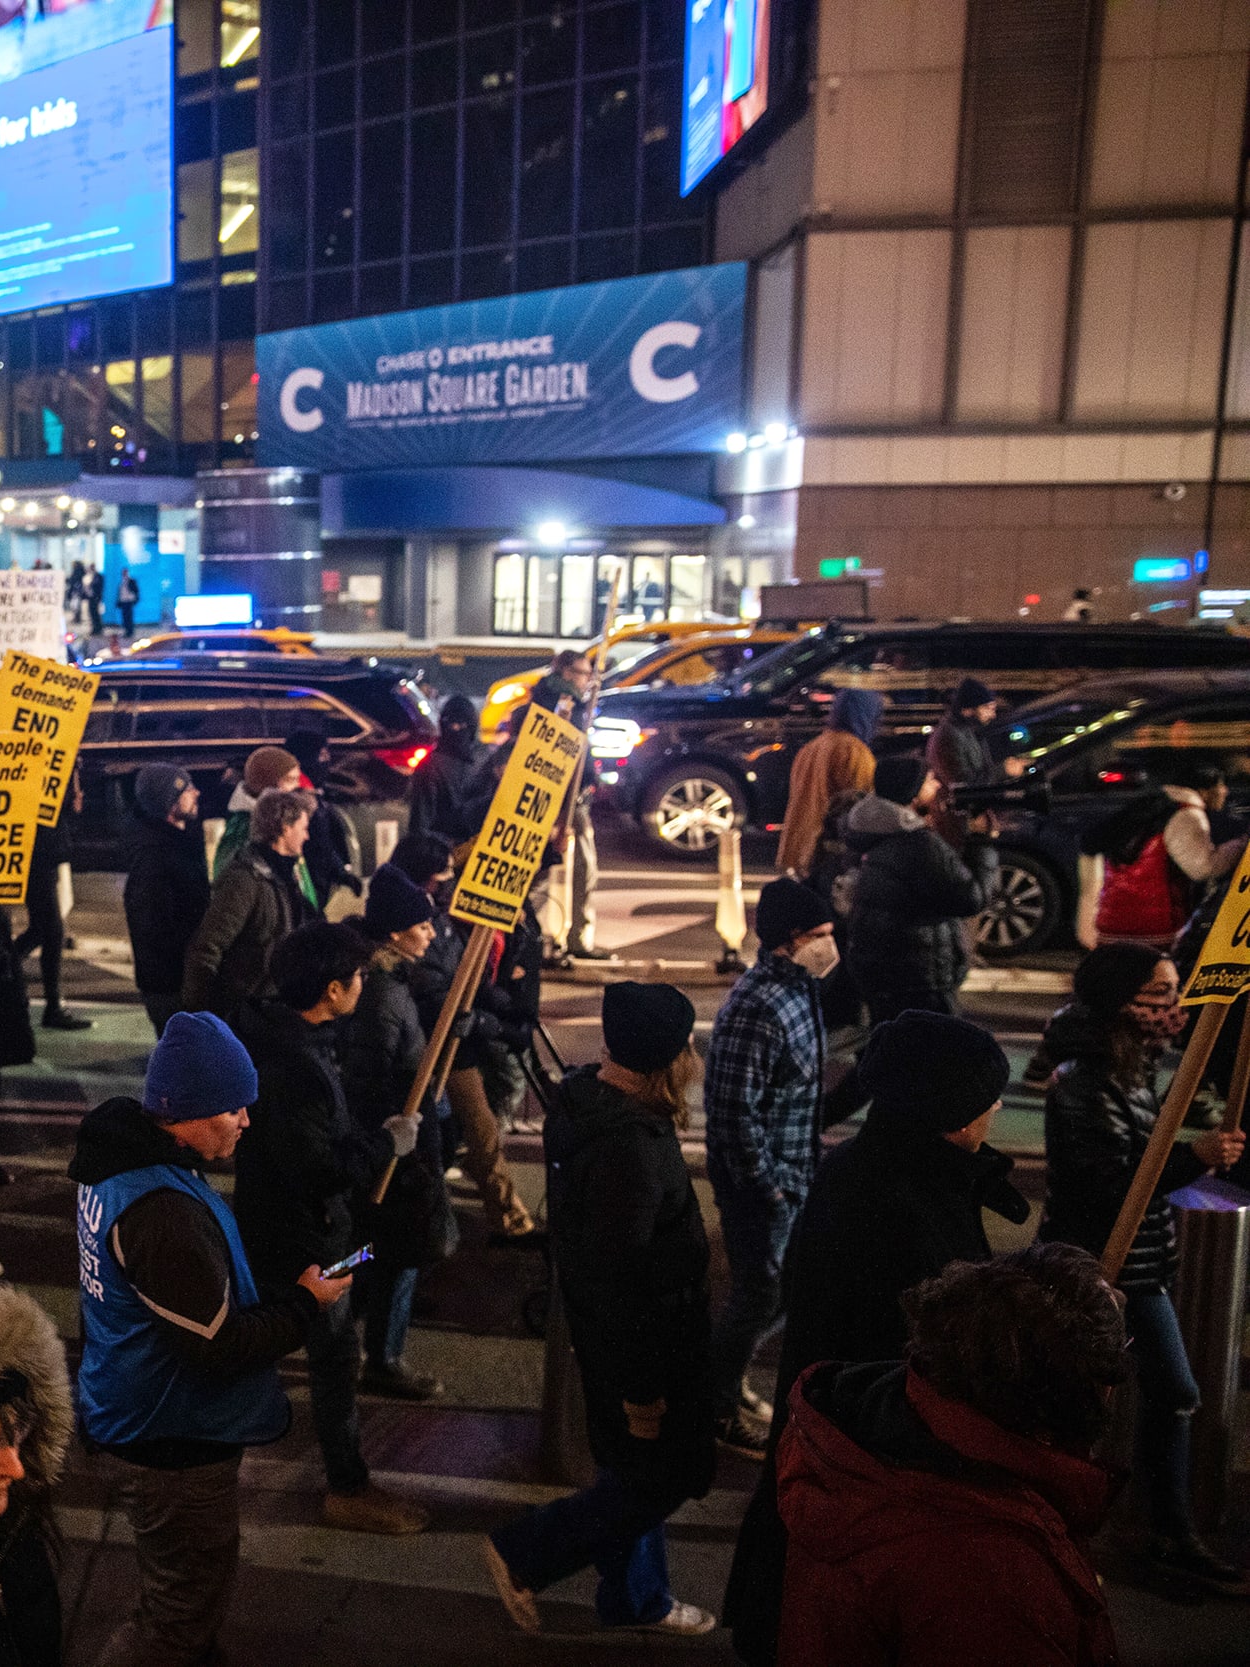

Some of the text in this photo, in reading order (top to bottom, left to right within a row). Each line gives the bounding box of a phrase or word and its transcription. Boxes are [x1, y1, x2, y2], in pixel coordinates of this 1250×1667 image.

[30, 98, 77, 138] kids
[376, 335, 554, 374] CHASE ENTRANCE
[630, 321, 701, 403] C
[280, 368, 324, 433] C
[347, 381, 424, 419] MADISON
[427, 371, 500, 413] SQUARE
[504, 362, 590, 406] GARDEN
[10, 655, 93, 693] The people
[11, 682, 77, 712] demand:
[12, 707, 60, 740] END
[528, 713, 581, 760] The people
[514, 782, 552, 825] END
[487, 817, 543, 864] POLICE
[471, 851, 531, 898] TERROR
